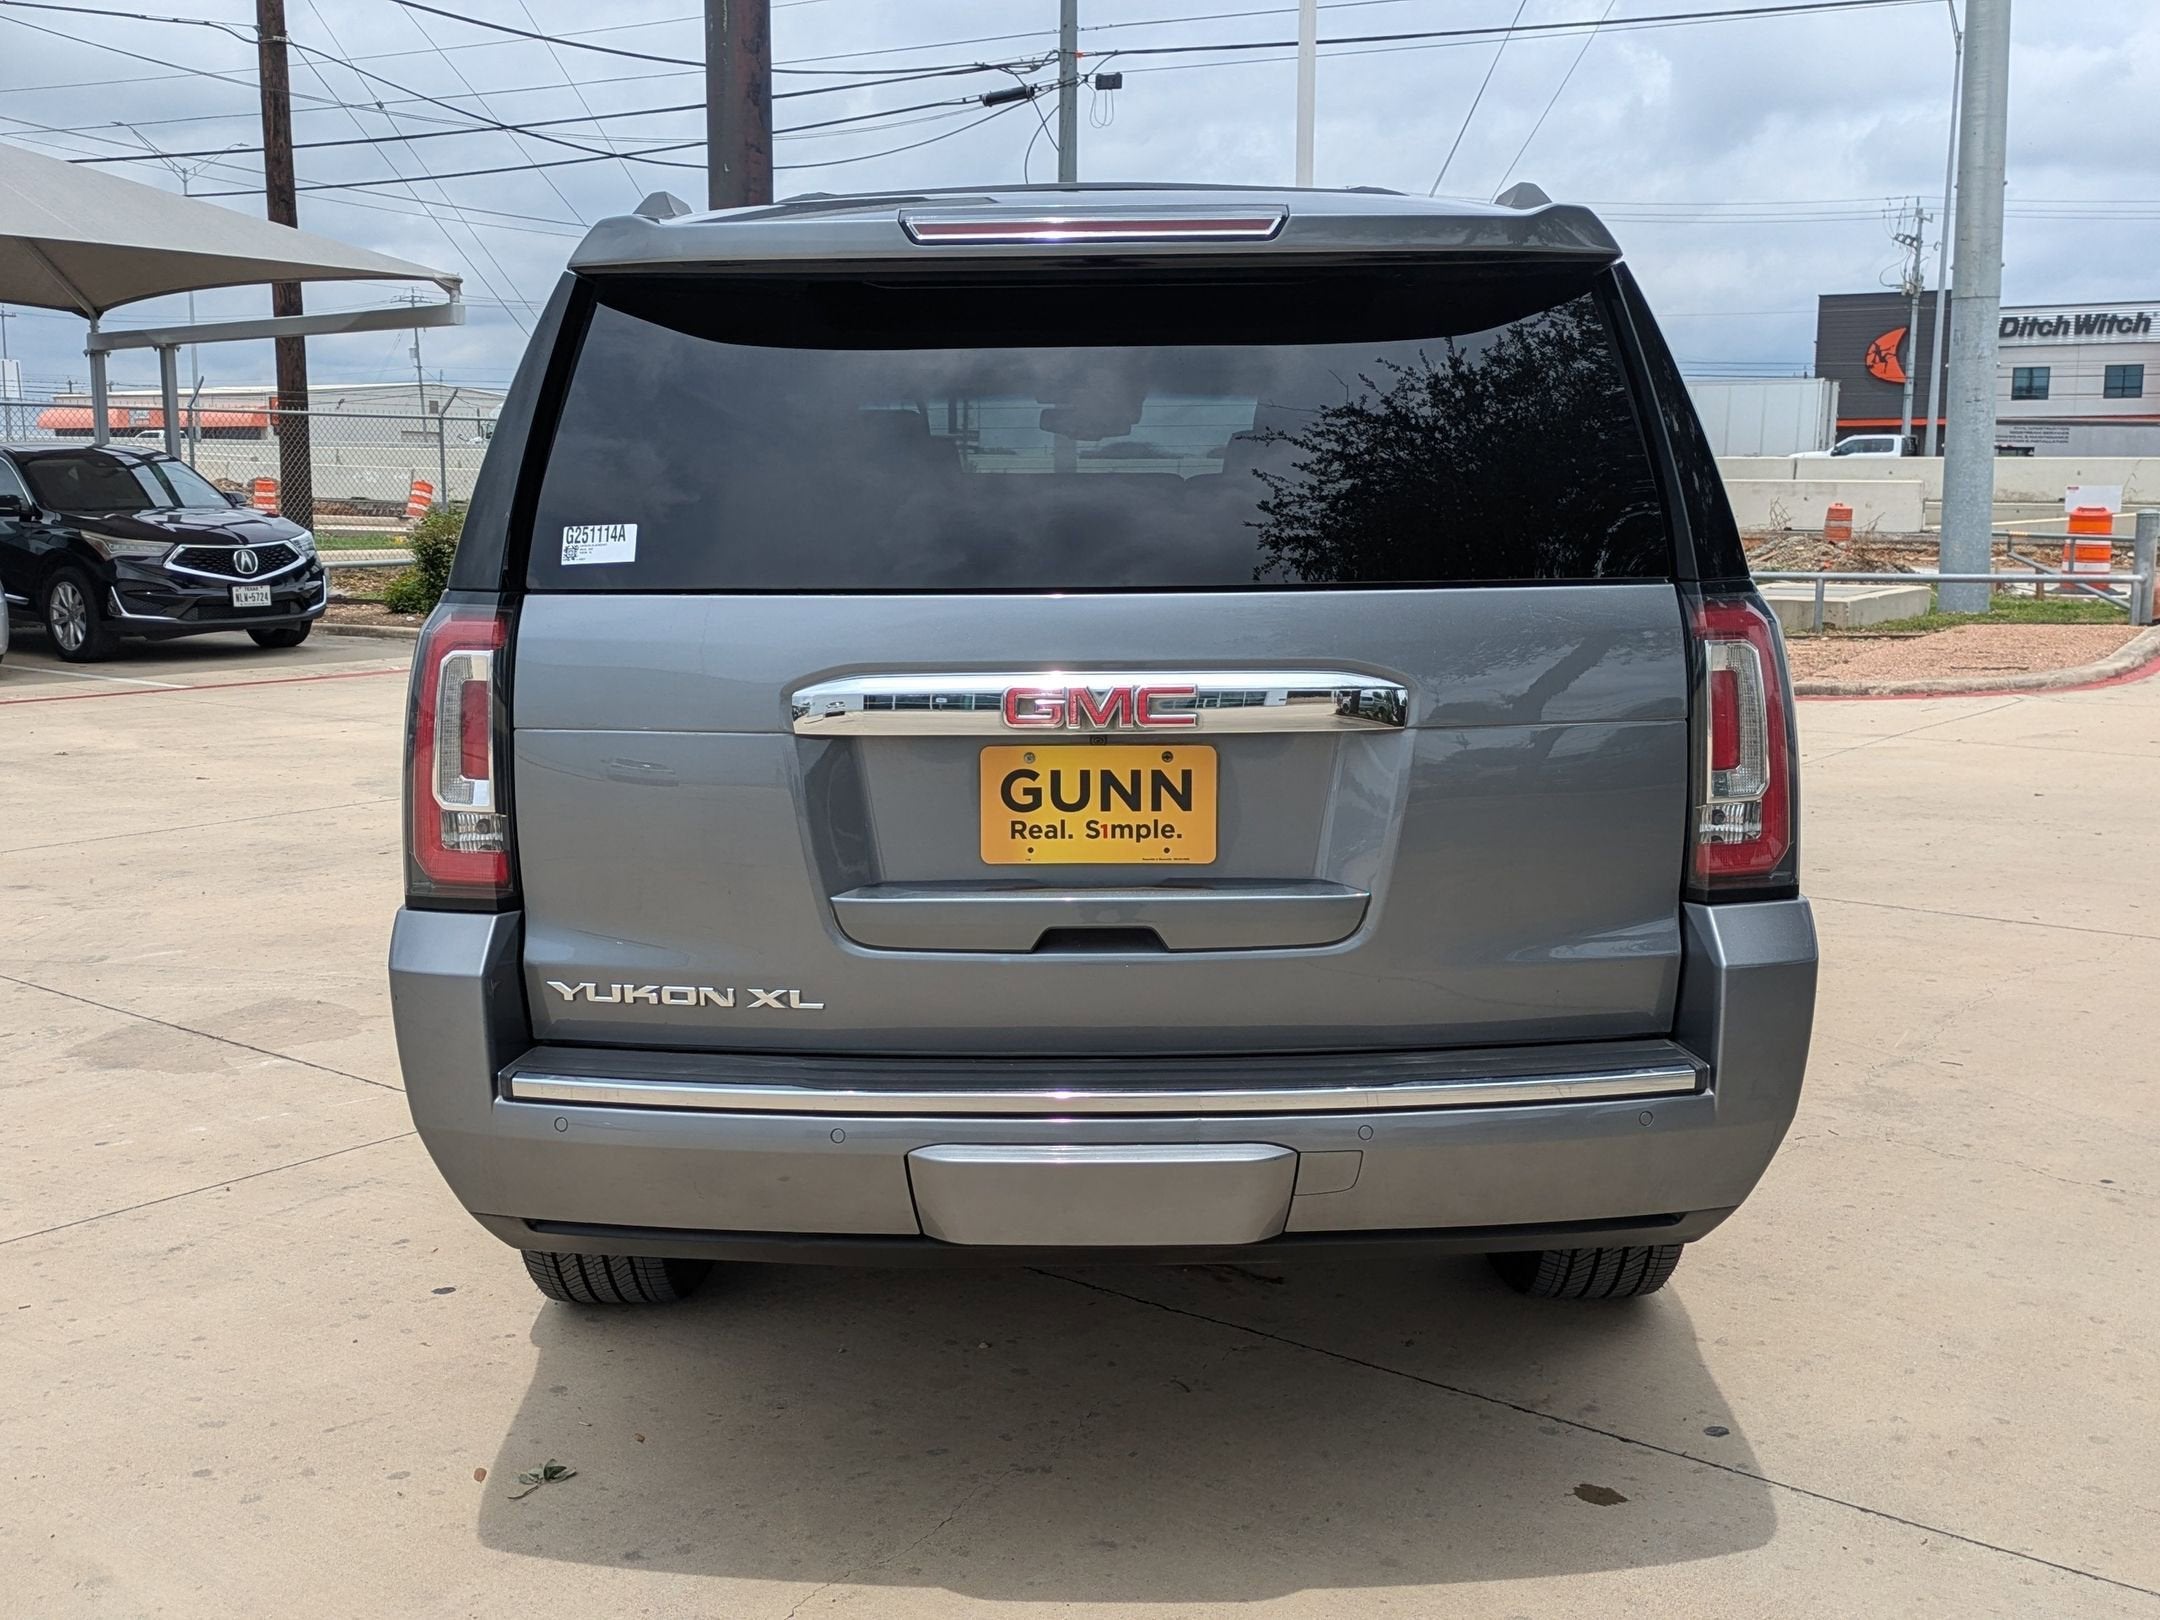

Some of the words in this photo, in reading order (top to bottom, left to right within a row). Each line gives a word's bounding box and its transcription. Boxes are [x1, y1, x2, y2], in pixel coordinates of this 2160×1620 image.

[1999, 315, 2071, 338] Ditch
[2074, 312, 2152, 335] Witch
[566, 525, 626, 544] G251114A
[1001, 685, 1198, 729] GMC
[1001, 768, 1193, 813] GUNN
[1010, 819, 1074, 840] Real.
[546, 980, 736, 1008] YUKON
[746, 988, 825, 1009] XL
